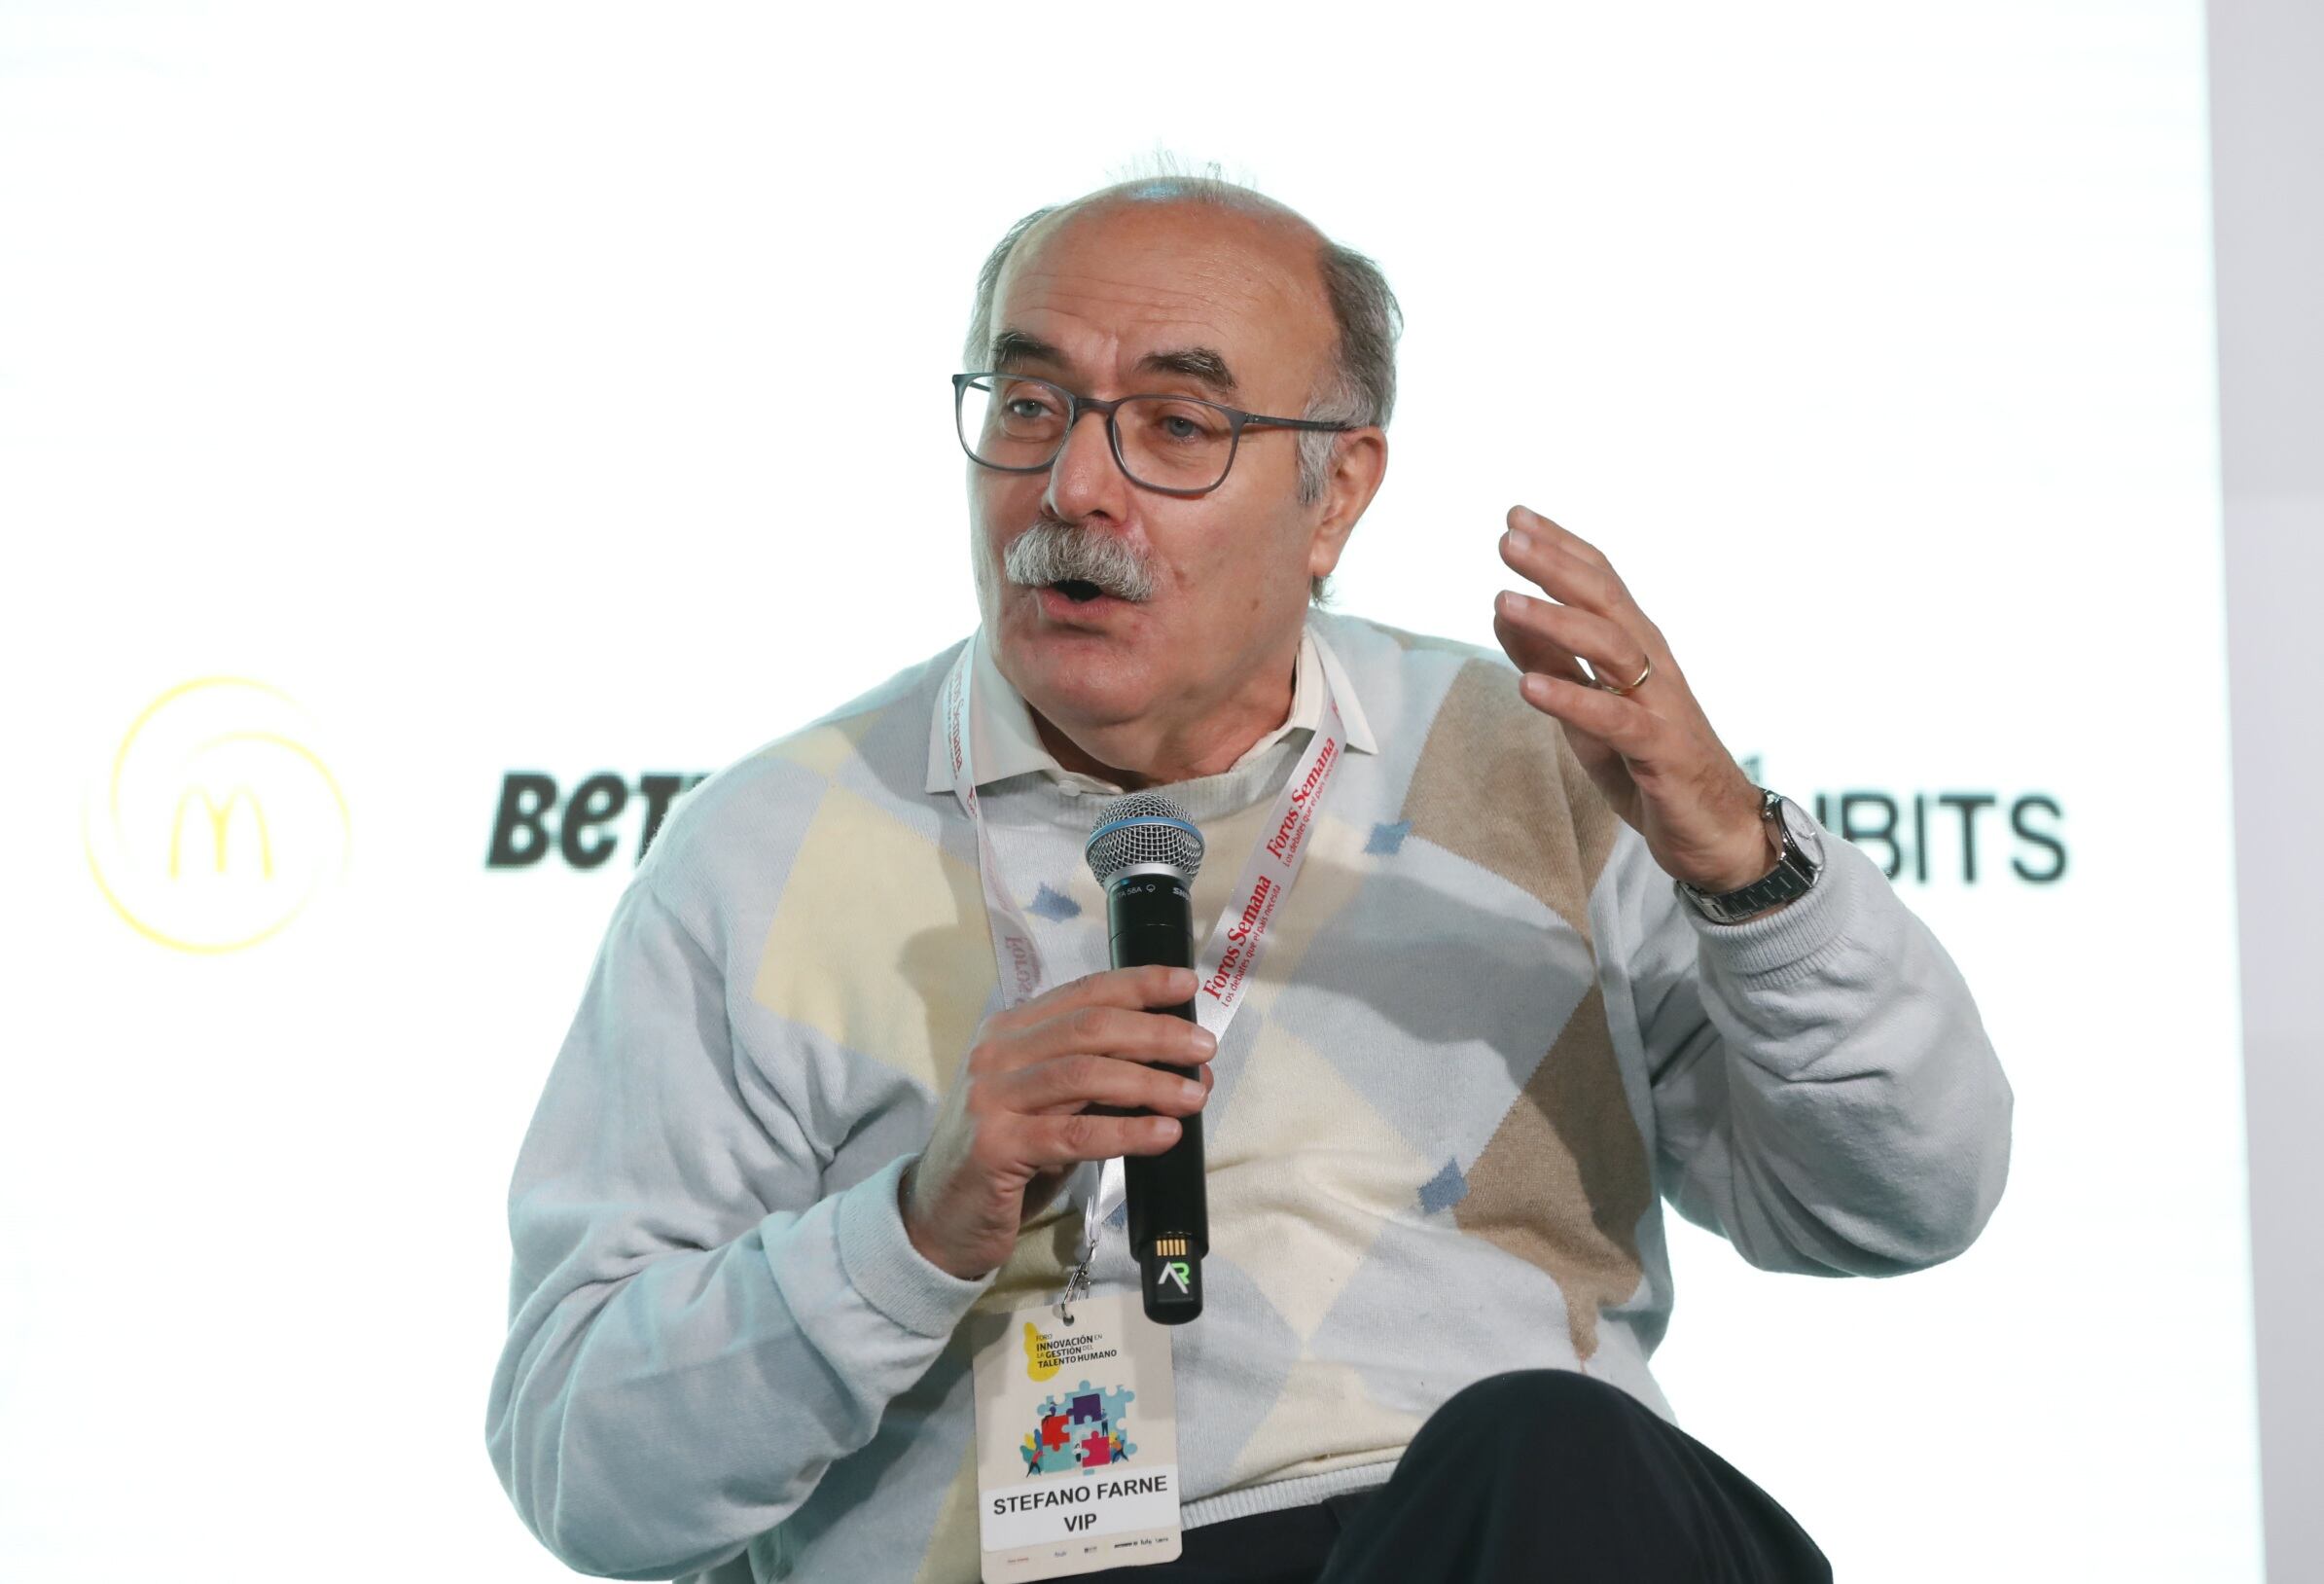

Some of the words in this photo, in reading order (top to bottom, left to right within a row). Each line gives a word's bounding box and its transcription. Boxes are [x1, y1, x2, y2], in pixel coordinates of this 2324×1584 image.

[1267, 807, 1300, 859] Foros
[1292, 738, 1336, 809] Semana
[1282, 852, 1294, 868] Los
[1290, 822, 1305, 854] debates
[1304, 808, 1313, 824] que
[1814, 791, 2069, 884] BITS
[1203, 946, 1240, 1000] Foros
[1228, 875, 1271, 947] Semana
[1222, 992, 1234, 1007] Los
[1232, 960, 1250, 992] debates
[1247, 942, 1258, 957] que
[1253, 931, 1261, 942] el
[1266, 884, 1281, 918] necesita
[1036, 1335, 1093, 1352] INNOVACIÓN
[1038, 1356, 1076, 1369] TALENTO
[1077, 1350, 1118, 1362] HUMANO
[1045, 1346, 1082, 1359] GESTIÓN
[993, 1486, 1090, 1515] STEFANO
[1097, 1475, 1168, 1499] FARNE
[1064, 1513, 1097, 1532] VIP
